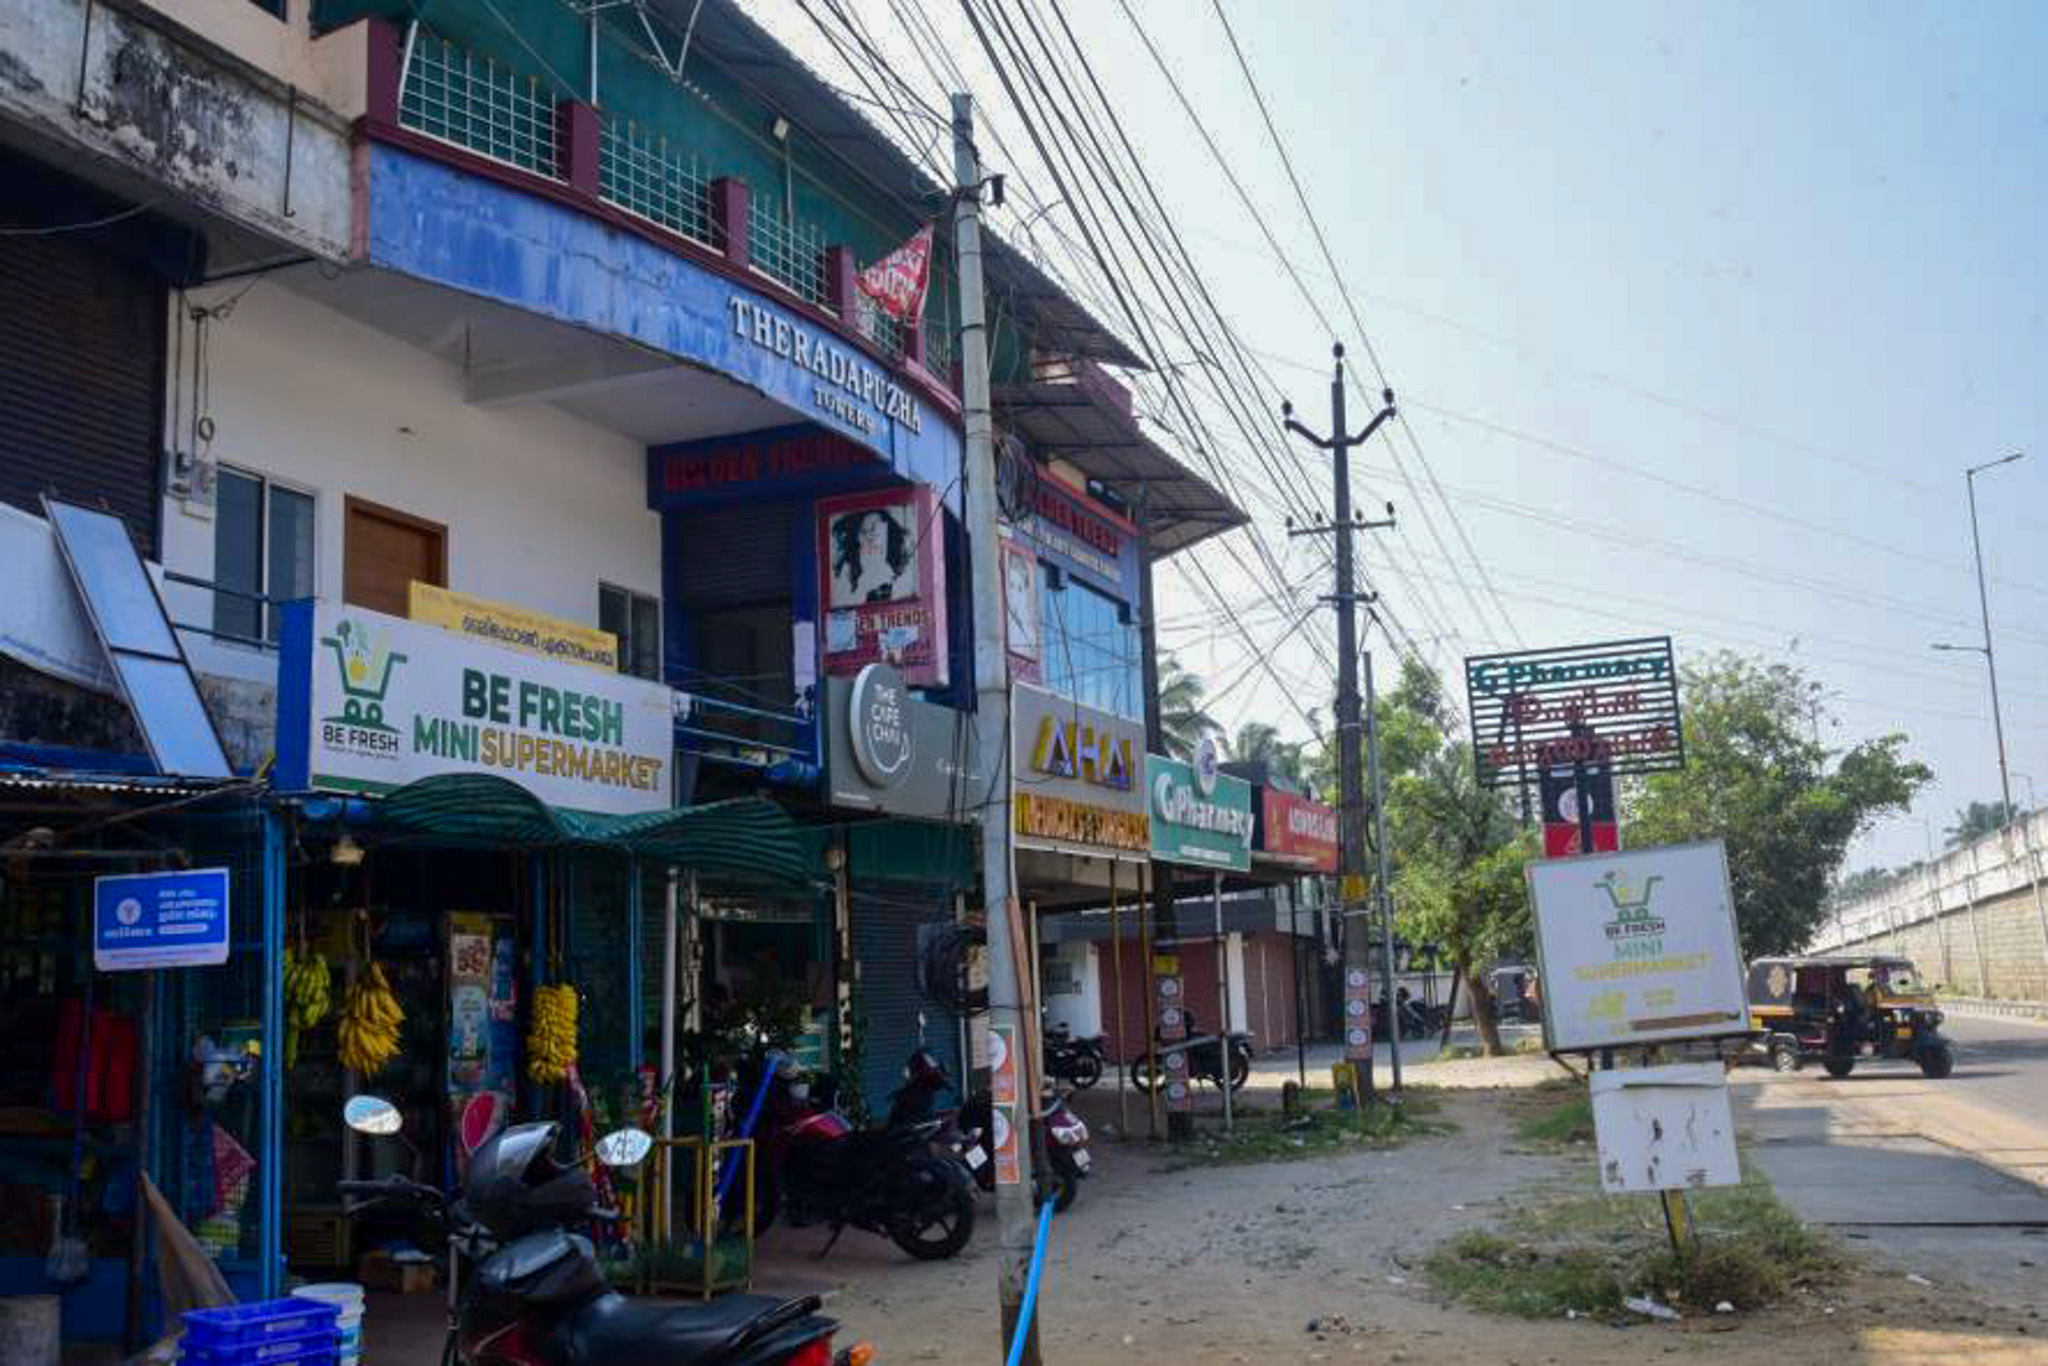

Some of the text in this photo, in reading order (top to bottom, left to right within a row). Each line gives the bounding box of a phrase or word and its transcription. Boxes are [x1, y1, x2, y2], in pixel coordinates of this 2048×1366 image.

[729, 295, 921, 434] THERADAPUZHA
[814, 387, 874, 435] TOWERS
[323, 725, 399, 752] BE FRESH
[462, 668, 622, 746] BE FRESH
[413, 714, 663, 791] MINI SUPERMARKET
